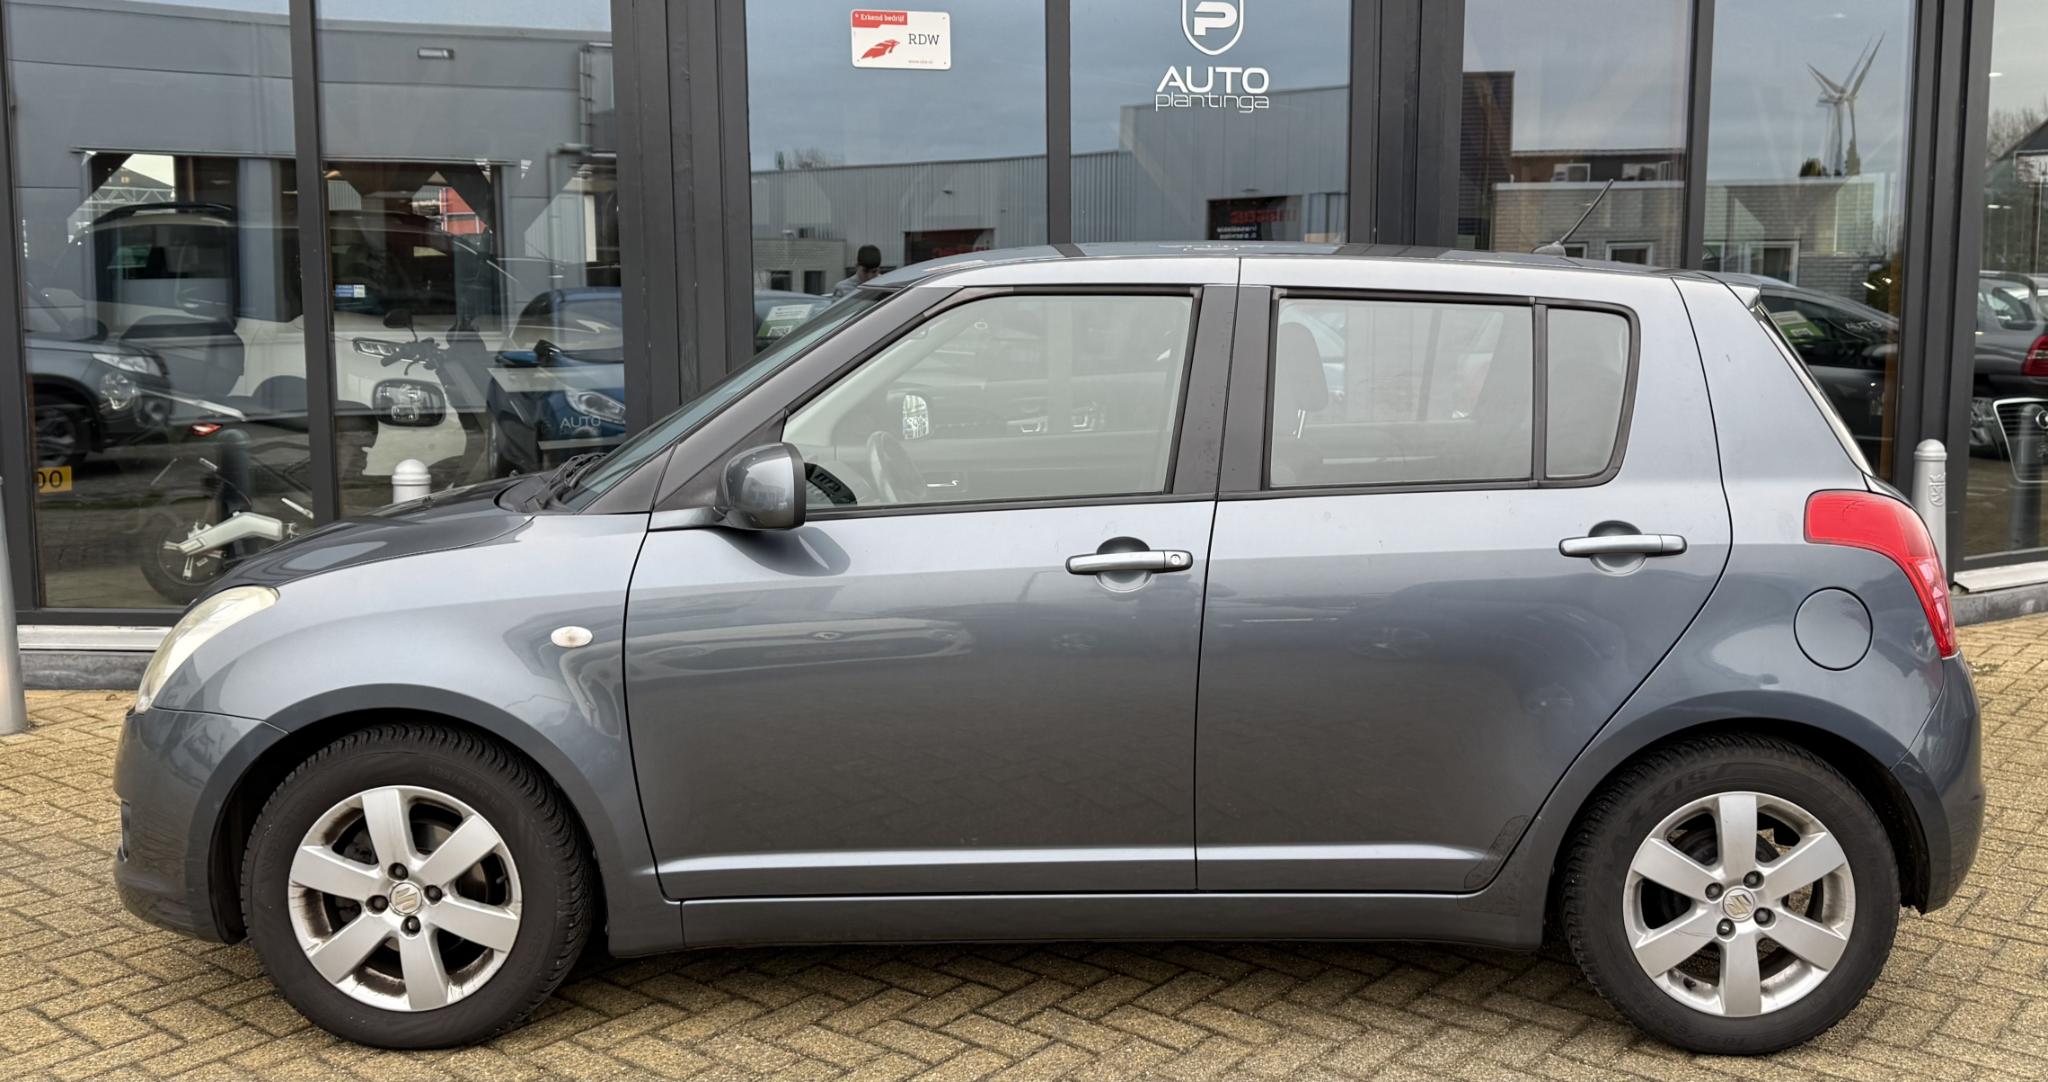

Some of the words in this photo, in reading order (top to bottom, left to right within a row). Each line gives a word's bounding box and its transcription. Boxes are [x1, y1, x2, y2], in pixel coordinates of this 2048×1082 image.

[908, 33, 940, 46] RDW
[1156, 65, 1270, 94] AUTO
[1156, 91, 1270, 114] plantinga
[560, 416, 601, 429] AUTO
